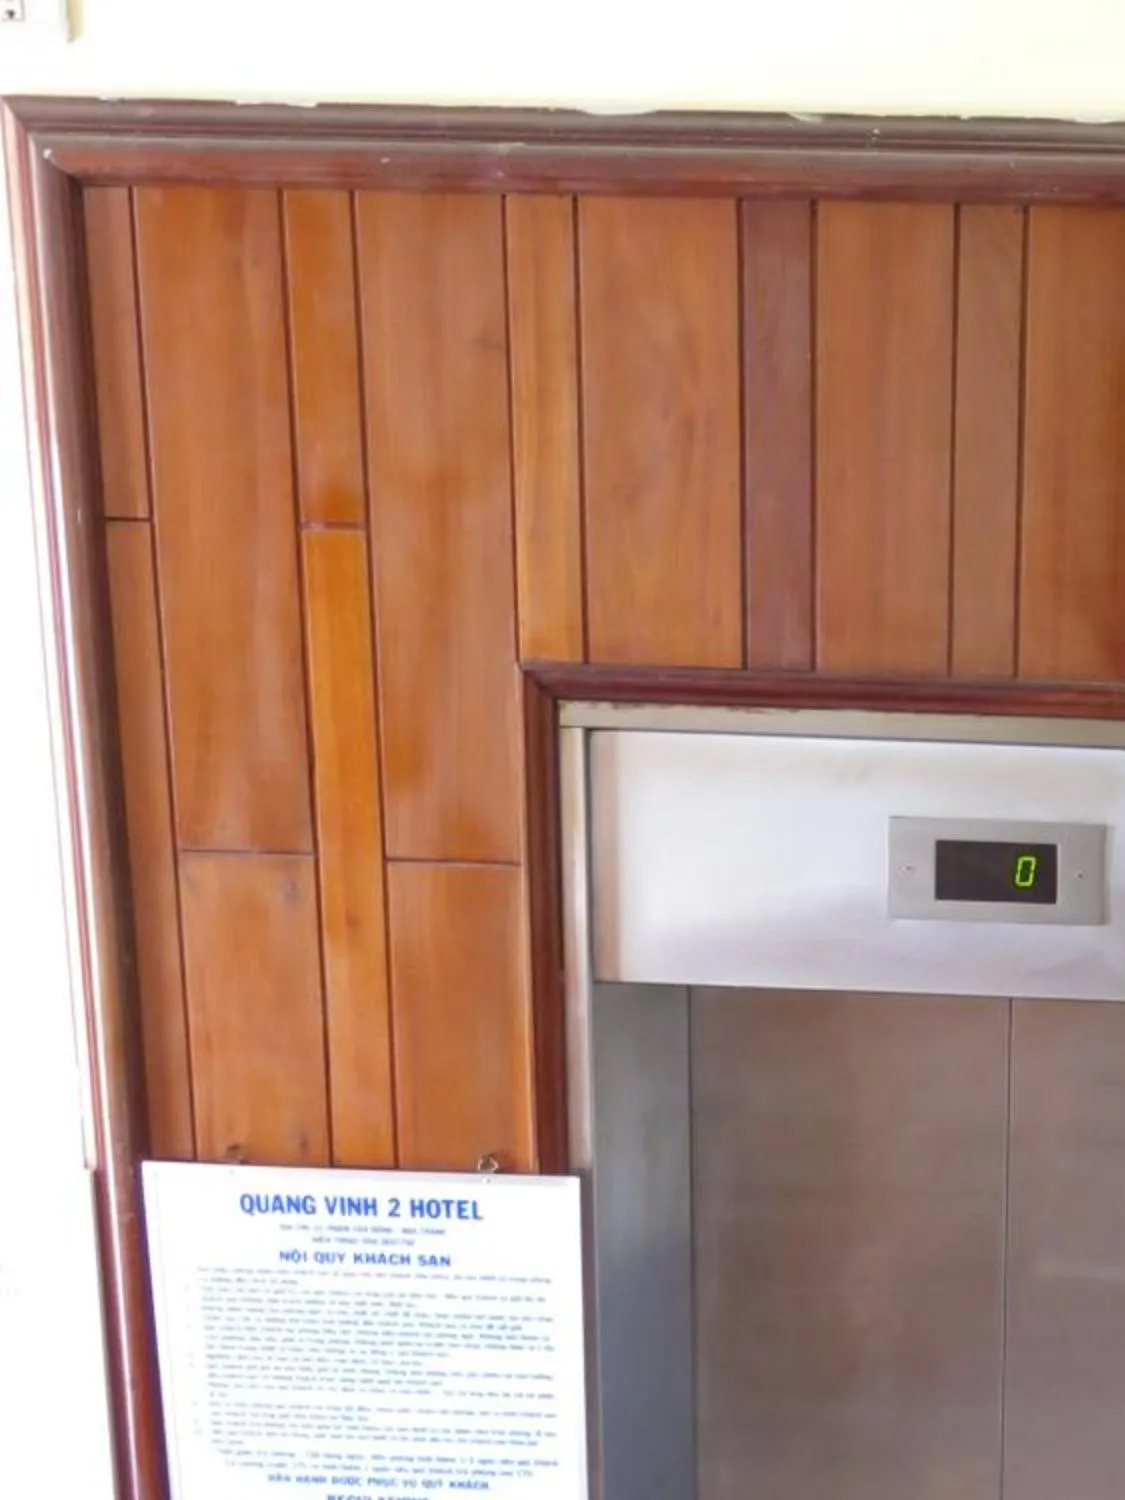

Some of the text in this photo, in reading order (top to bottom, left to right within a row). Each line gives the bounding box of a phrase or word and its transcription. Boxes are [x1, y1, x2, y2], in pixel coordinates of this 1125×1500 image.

[1015, 856, 1036, 886] 0
[240, 1193, 483, 1221] QUANG VINH 2 HOTEL
